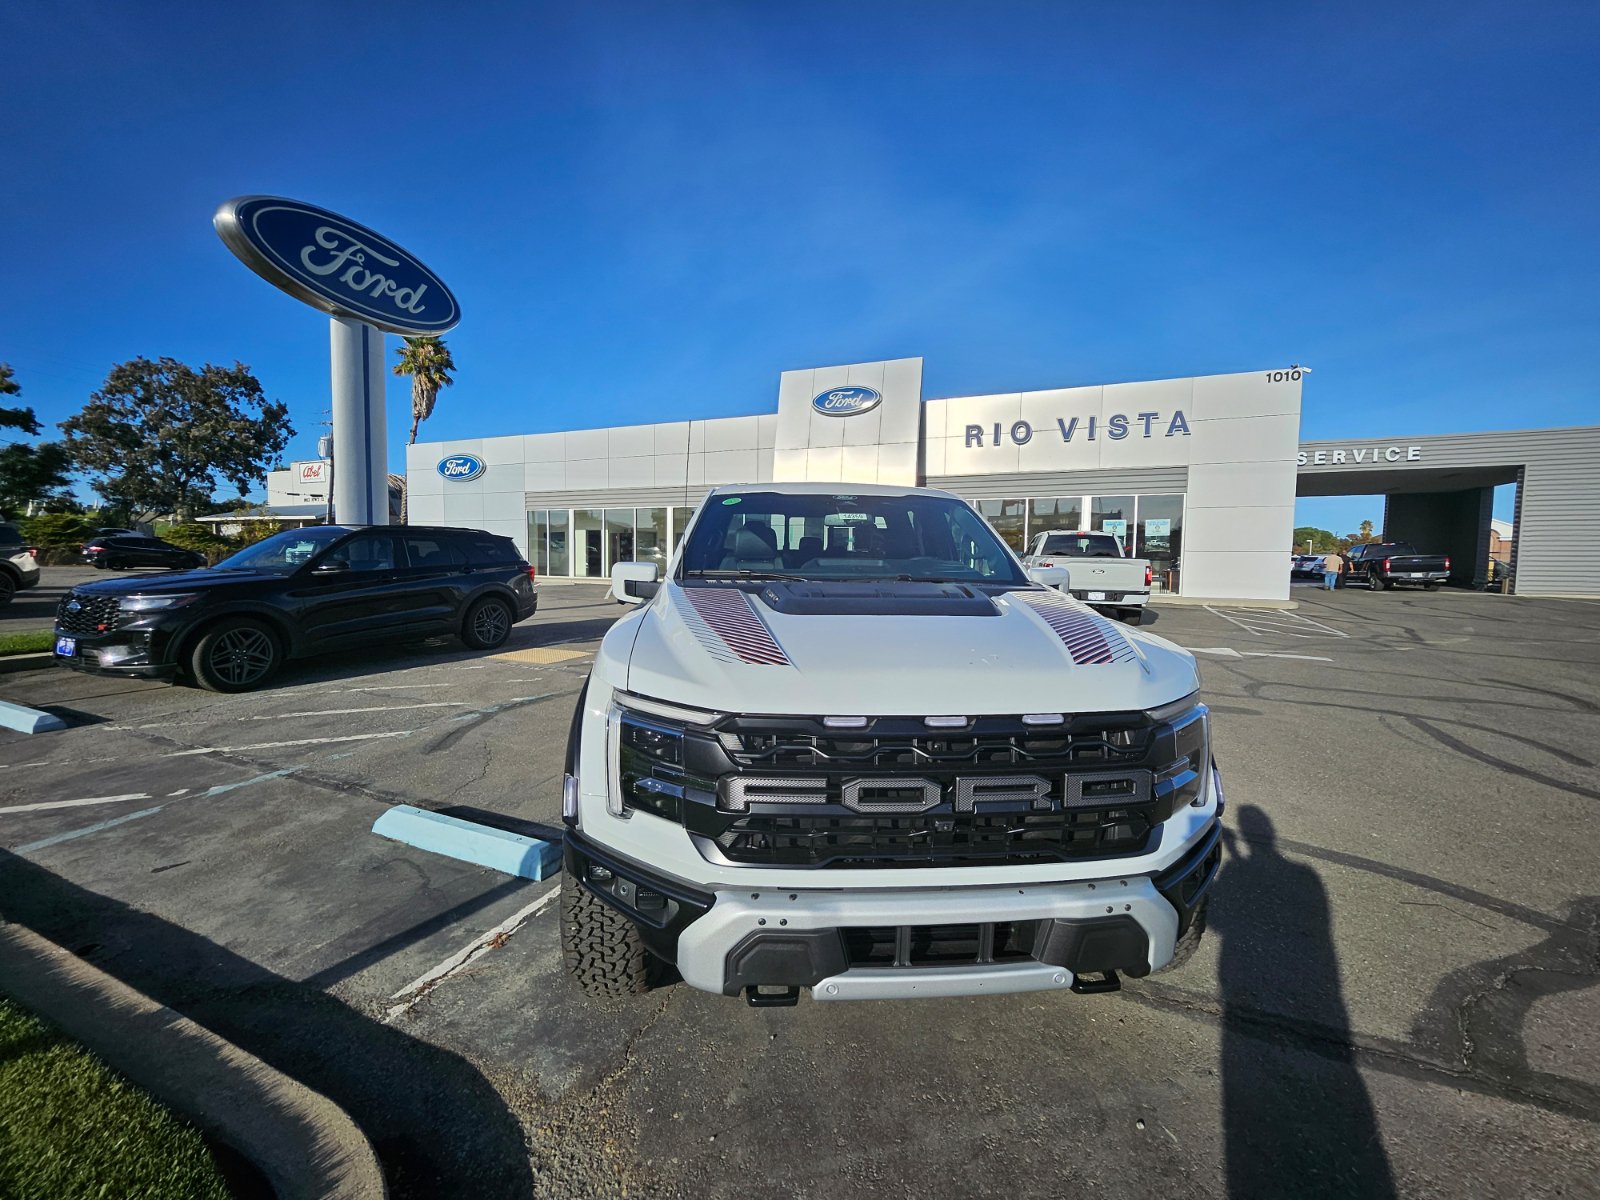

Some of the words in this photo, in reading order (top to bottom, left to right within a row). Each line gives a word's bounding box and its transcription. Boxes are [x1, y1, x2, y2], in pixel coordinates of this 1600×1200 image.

[301, 226, 428, 314] Ford
[1266, 370, 1301, 383] 1010
[825, 390, 864, 408] Ford
[965, 420, 1033, 448] RIO
[1057, 410, 1192, 443] VISTA
[1297, 446, 1421, 466] SERVICE
[445, 459, 471, 475] Ford
[721, 771, 1153, 813] FORD
